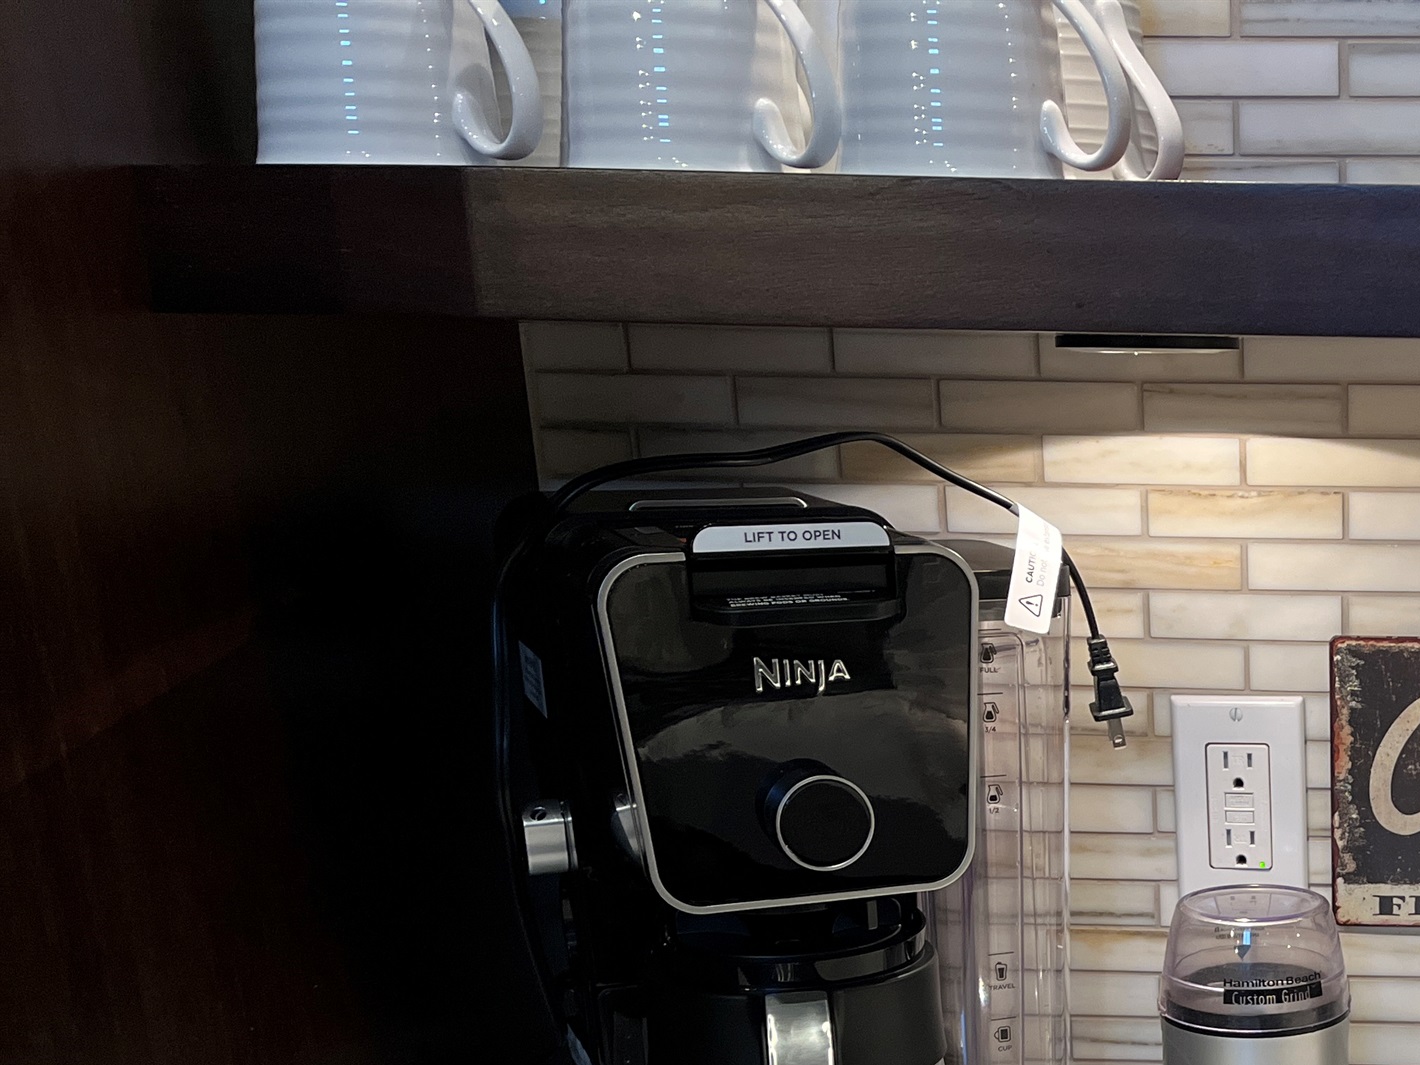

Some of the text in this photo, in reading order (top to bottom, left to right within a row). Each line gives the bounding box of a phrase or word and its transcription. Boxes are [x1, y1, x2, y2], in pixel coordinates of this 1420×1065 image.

[744, 529, 841, 543] LIFT TO OPEN
[753, 657, 851, 695] NINJA
[989, 983, 1016, 991] TRAVEL
[1232, 987, 1311, 1005] Custom Grind
